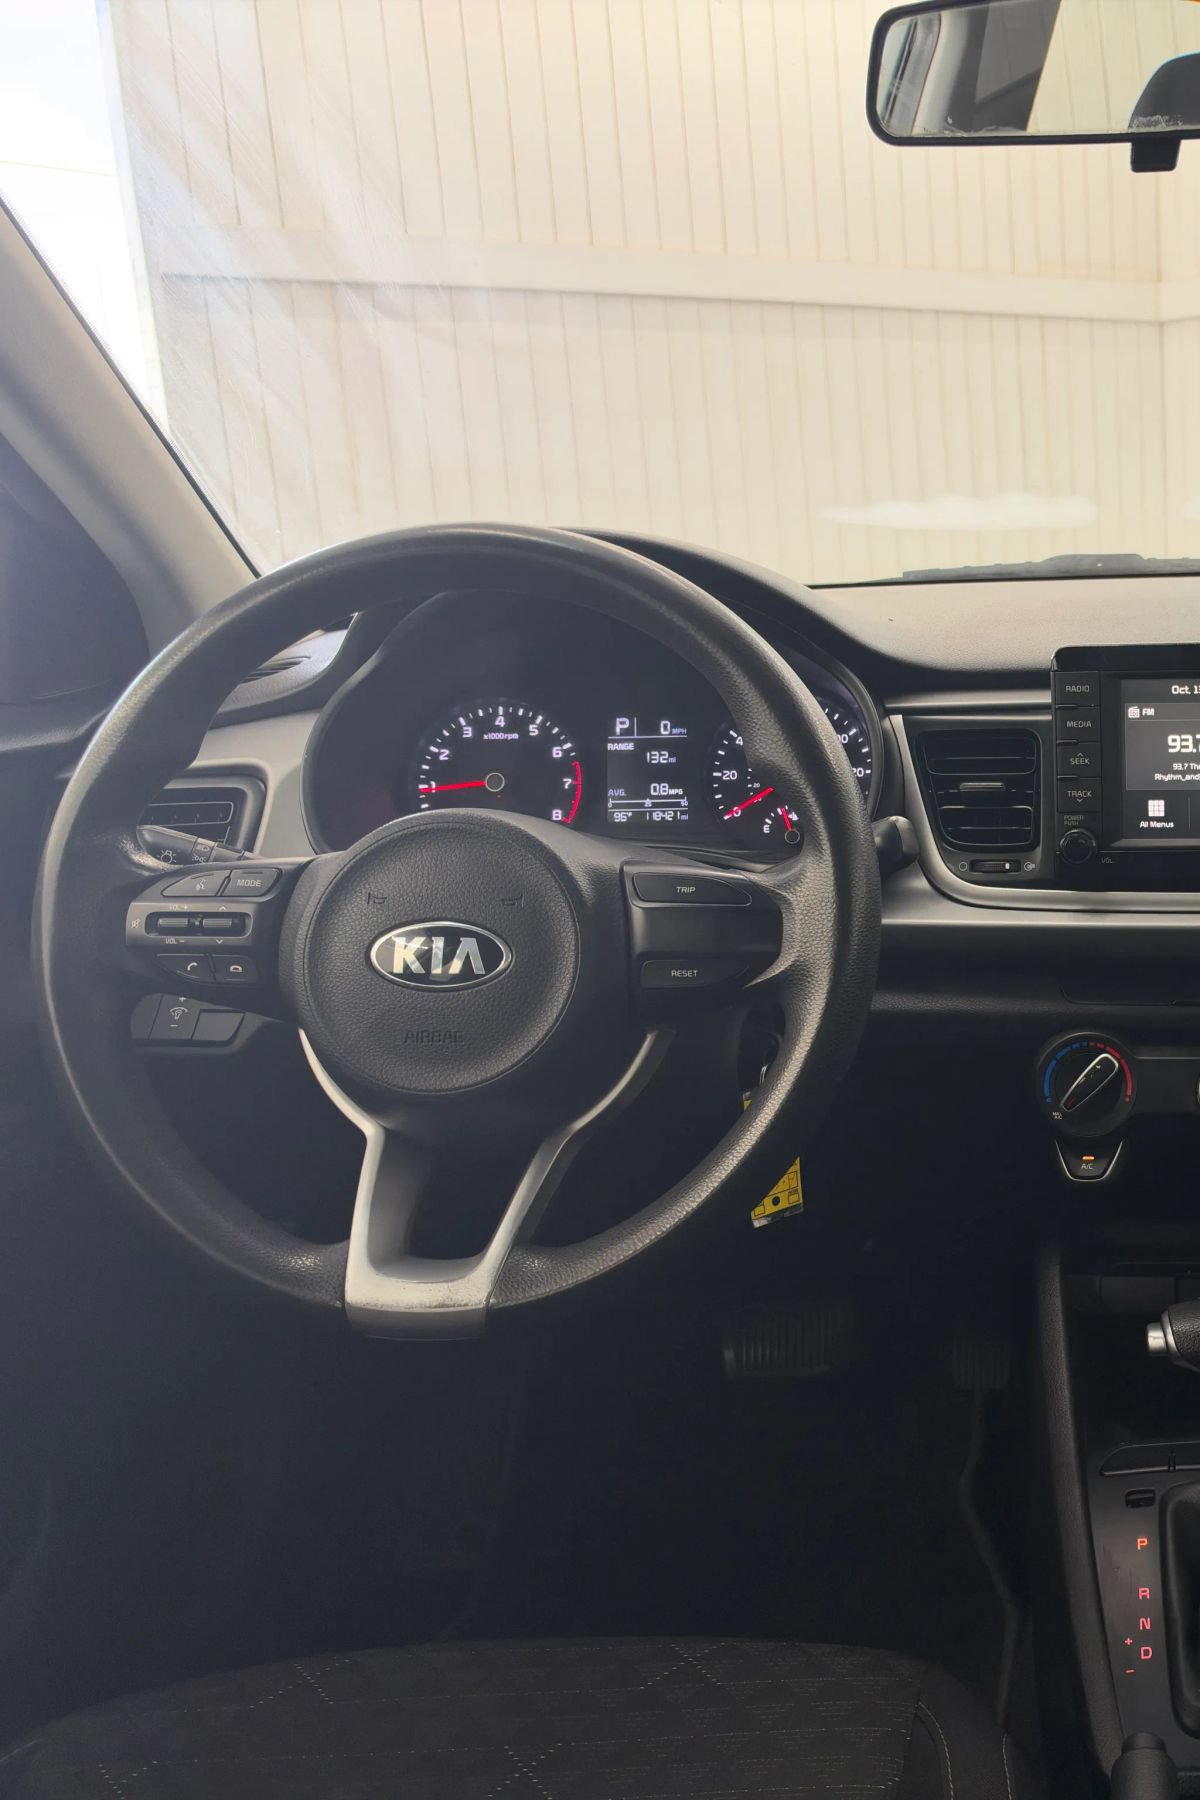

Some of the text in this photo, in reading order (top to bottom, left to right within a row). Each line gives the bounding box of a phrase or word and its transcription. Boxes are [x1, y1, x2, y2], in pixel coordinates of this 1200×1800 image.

[1065, 685, 1090, 693] RADIO
[1142, 708, 1155, 716] FM
[494, 715, 505, 728] 4
[615, 717, 630, 736] P
[1066, 720, 1092, 728] MEDIA
[462, 726, 473, 739] 3
[528, 724, 539, 737] 5
[552, 746, 562, 758] 6
[607, 742, 635, 751] RANGE
[438, 749, 450, 761] 2
[1069, 757, 1090, 765] SEEK
[1172, 762, 1188, 771] 93.7
[722, 770, 738, 780] 20
[562, 777, 572, 789] 7
[1067, 790, 1092, 798] TRACK
[551, 809, 562, 821] 8
[763, 824, 770, 834] E
[236, 879, 262, 887] MODE
[391, 936, 486, 975] KIA
[671, 969, 699, 978] RESET
[403, 1029, 465, 1044] AIRBAG
[1136, 1537, 1148, 1550] P
[1138, 1587, 1150, 1600] R
[1139, 1617, 1151, 1630] N
[1140, 1646, 1153, 1660] D
